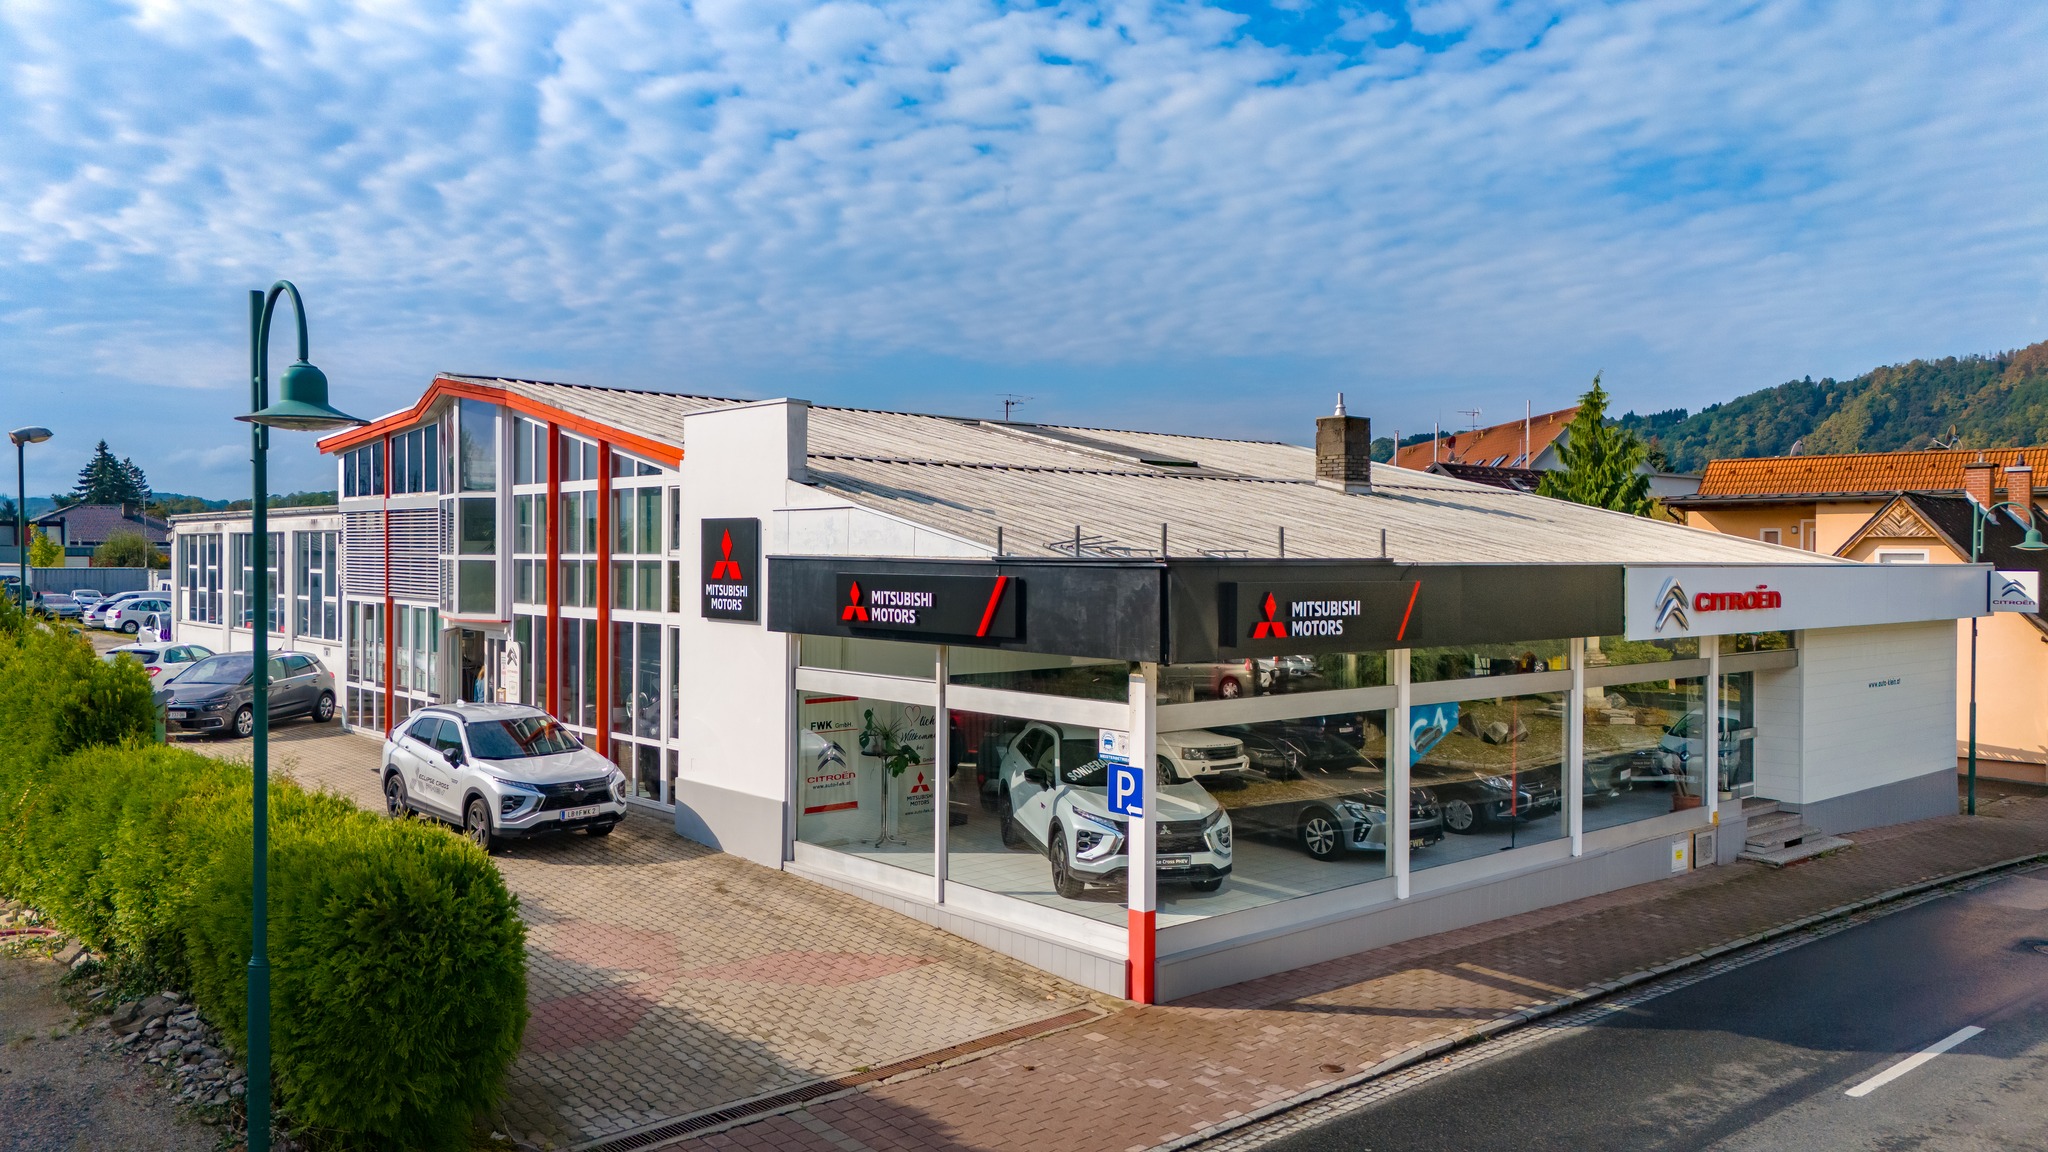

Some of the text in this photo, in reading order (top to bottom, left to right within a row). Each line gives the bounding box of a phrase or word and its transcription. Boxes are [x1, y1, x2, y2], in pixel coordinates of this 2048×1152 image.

[706, 584, 748, 598] MITSUBISHI
[871, 590, 932, 608] MITSUBISHI
[711, 598, 743, 611] MOTORS
[1291, 600, 1361, 618] MITSUBISHI
[871, 607, 916, 624] MOTORS
[1291, 619, 1344, 637] MOTORS
[811, 720, 833, 731] FWK
[1117, 770, 1135, 809] P
